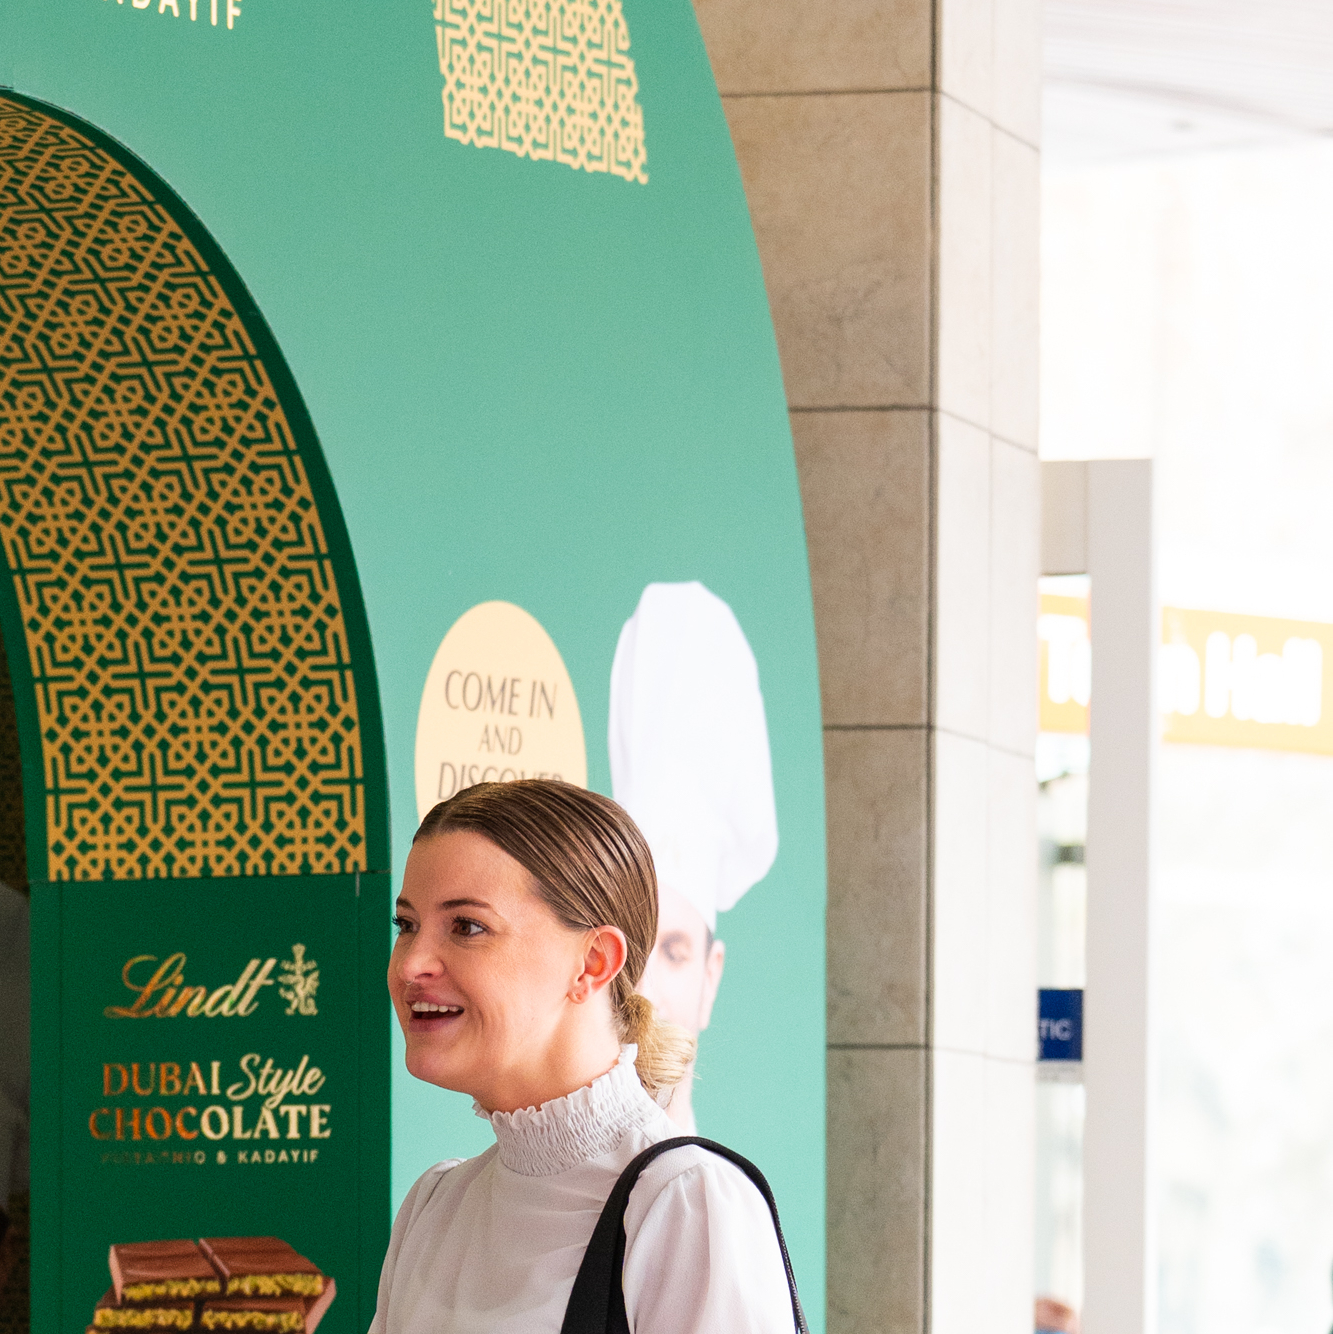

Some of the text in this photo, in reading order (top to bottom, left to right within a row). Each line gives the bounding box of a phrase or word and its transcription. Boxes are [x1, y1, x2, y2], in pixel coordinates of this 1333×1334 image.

[444, 669, 559, 720] COME IN
[477, 724, 524, 756] AND
[103, 952, 278, 1019] Lindt
[102, 1053, 327, 1110] DUBAI Style
[87, 1104, 333, 1141] CHOCOLATE
[237, 1149, 321, 1165] KADAYIF
